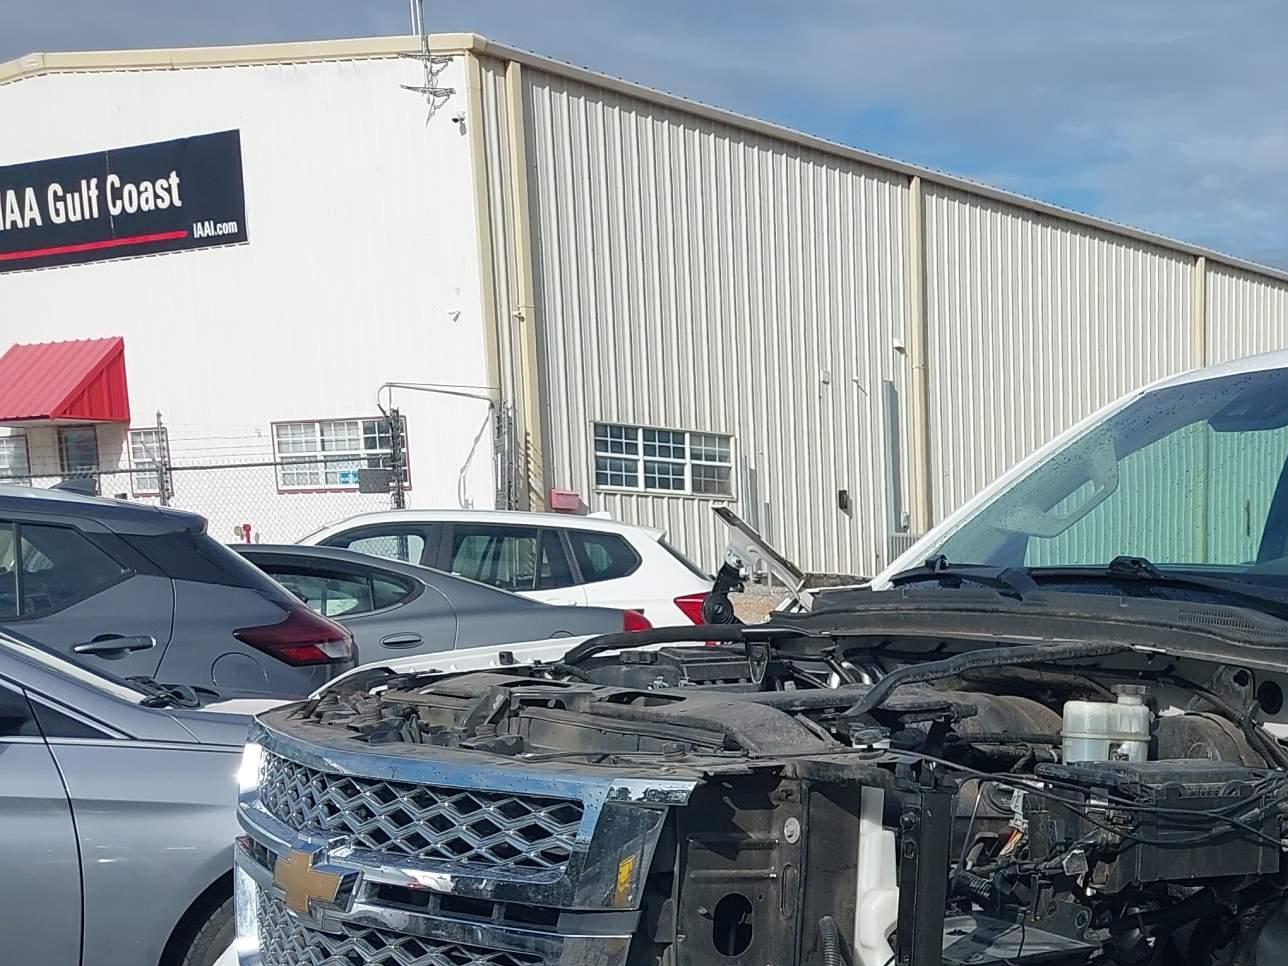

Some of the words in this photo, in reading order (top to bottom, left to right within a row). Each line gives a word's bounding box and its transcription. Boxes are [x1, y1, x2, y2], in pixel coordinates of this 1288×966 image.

[47, 177, 99, 224] Gulf
[106, 170, 182, 216] Coast
[193, 220, 238, 238] IAAI.com
